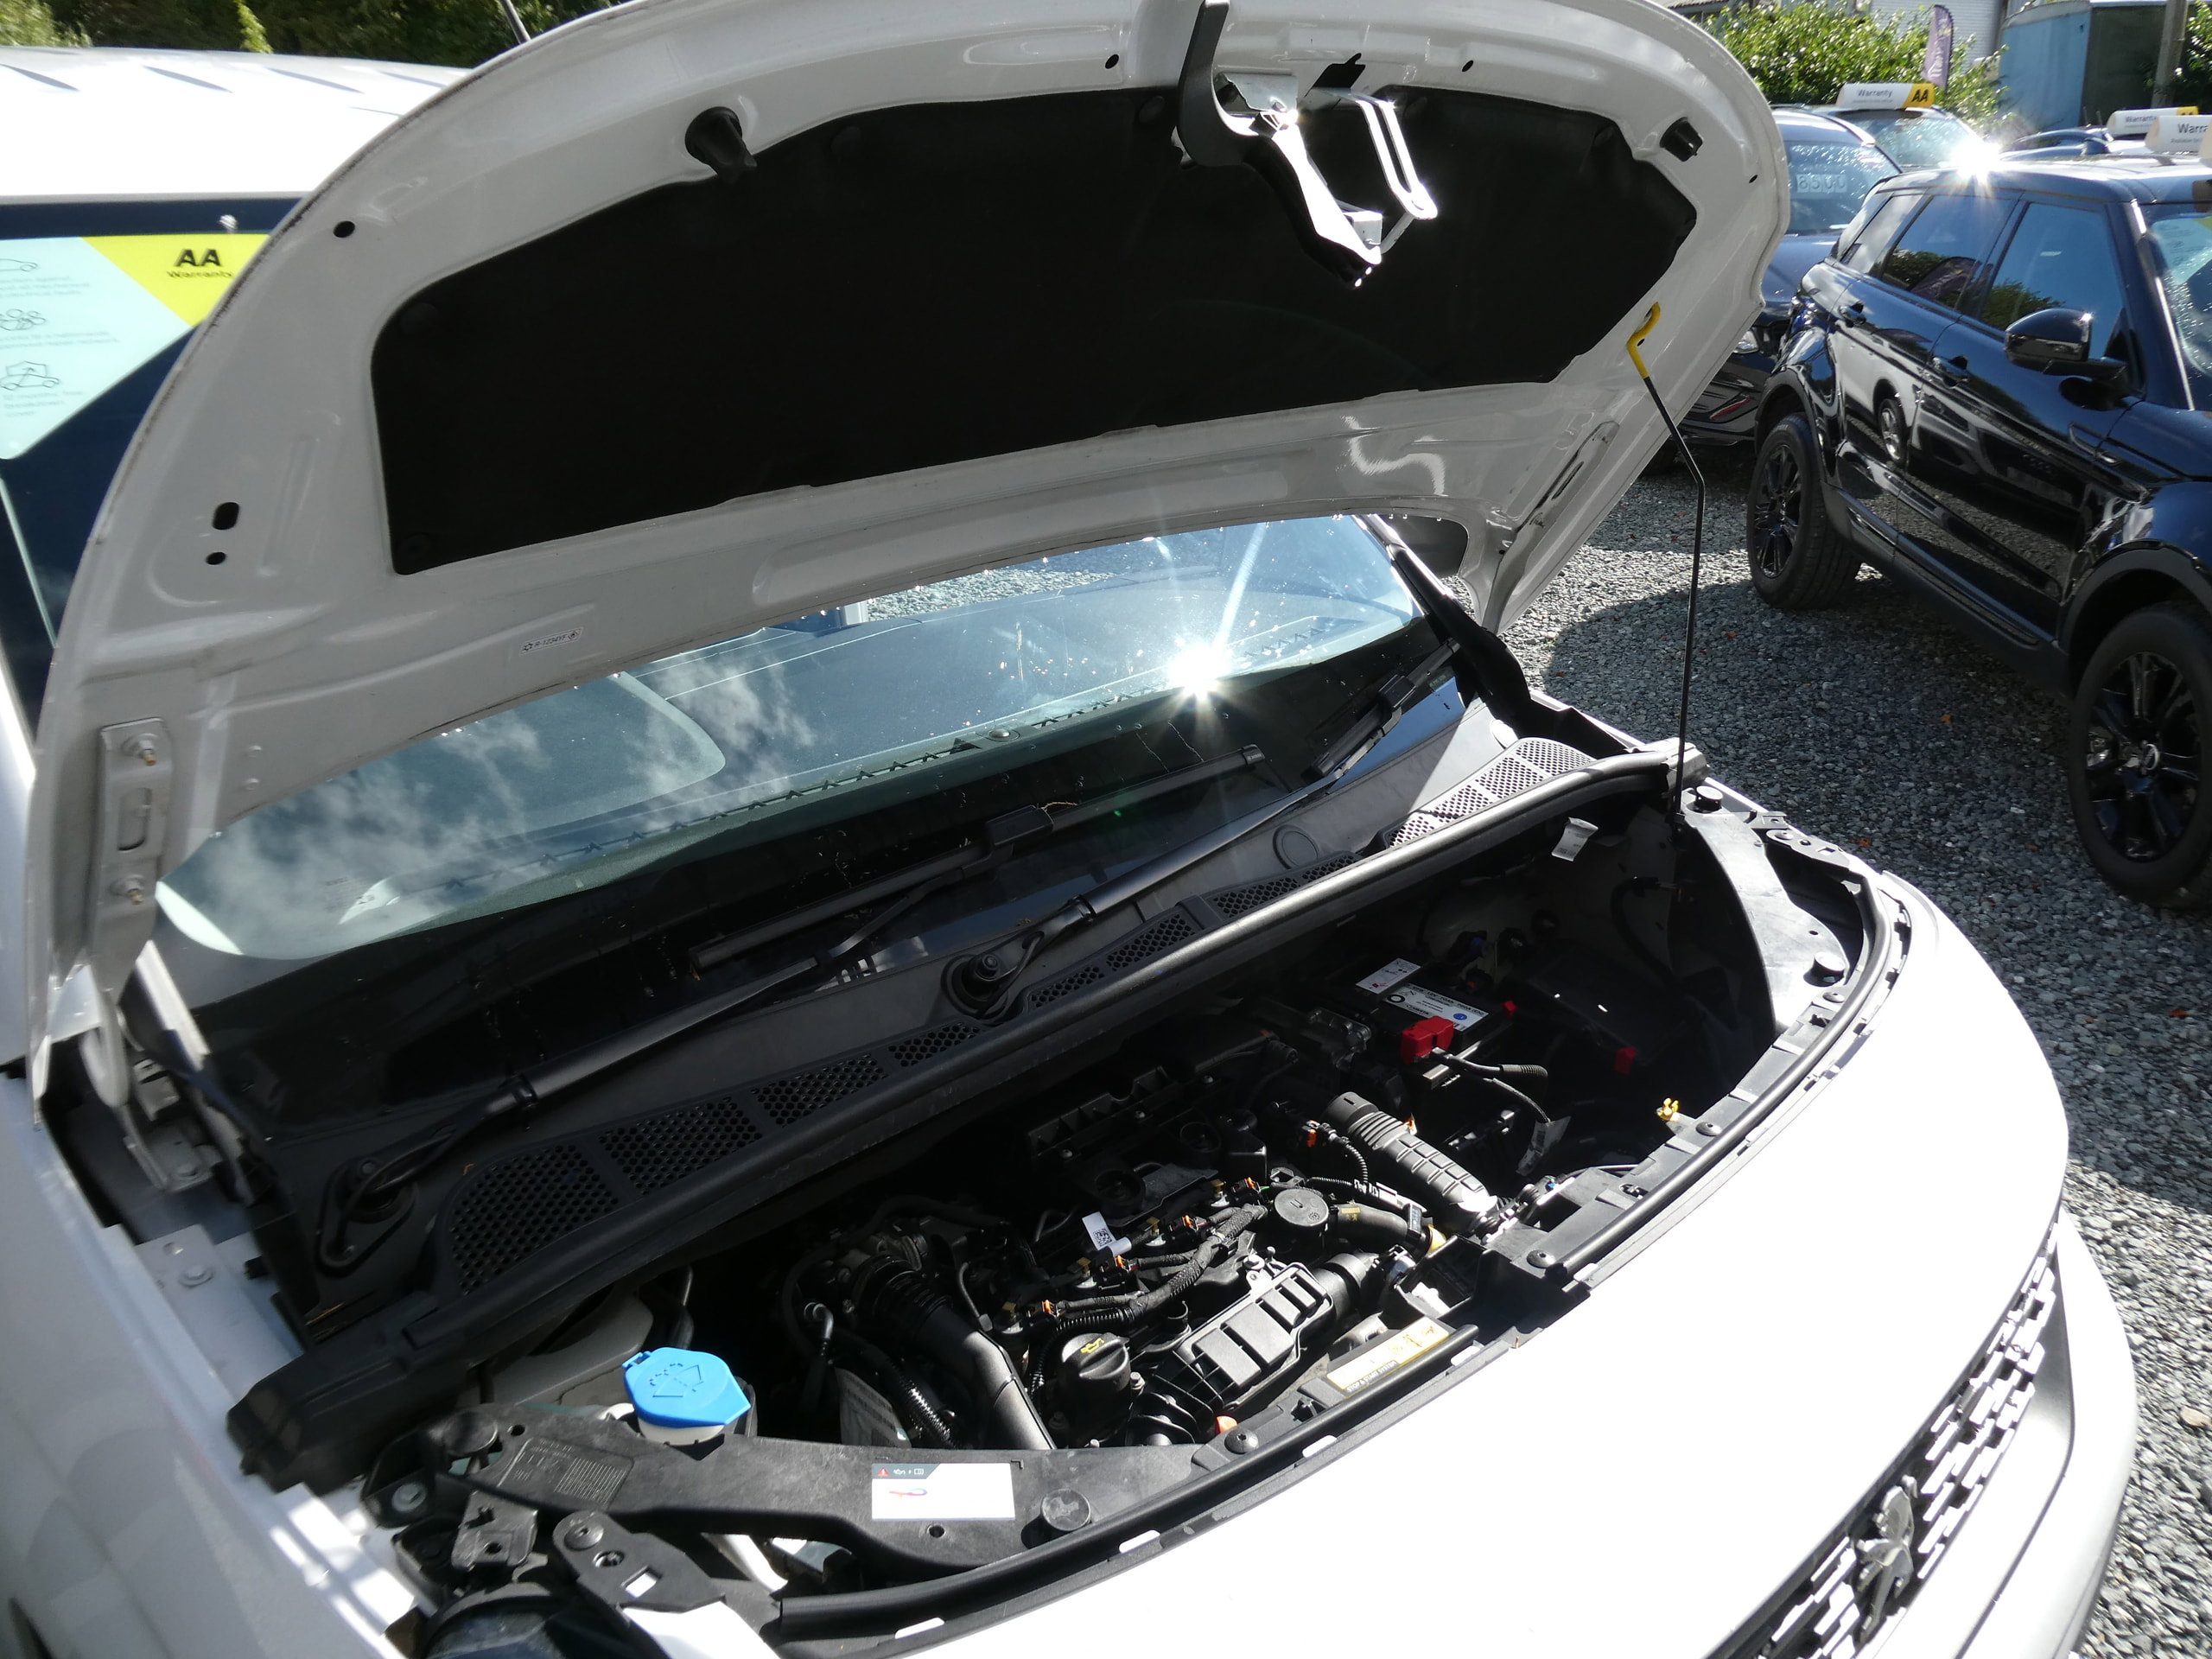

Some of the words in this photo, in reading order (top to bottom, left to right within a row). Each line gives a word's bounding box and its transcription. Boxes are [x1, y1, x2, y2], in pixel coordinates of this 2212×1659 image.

[1858, 89, 1893, 98] Warranty
[1911, 89, 1929, 102] AA
[175, 248, 221, 267] AA
